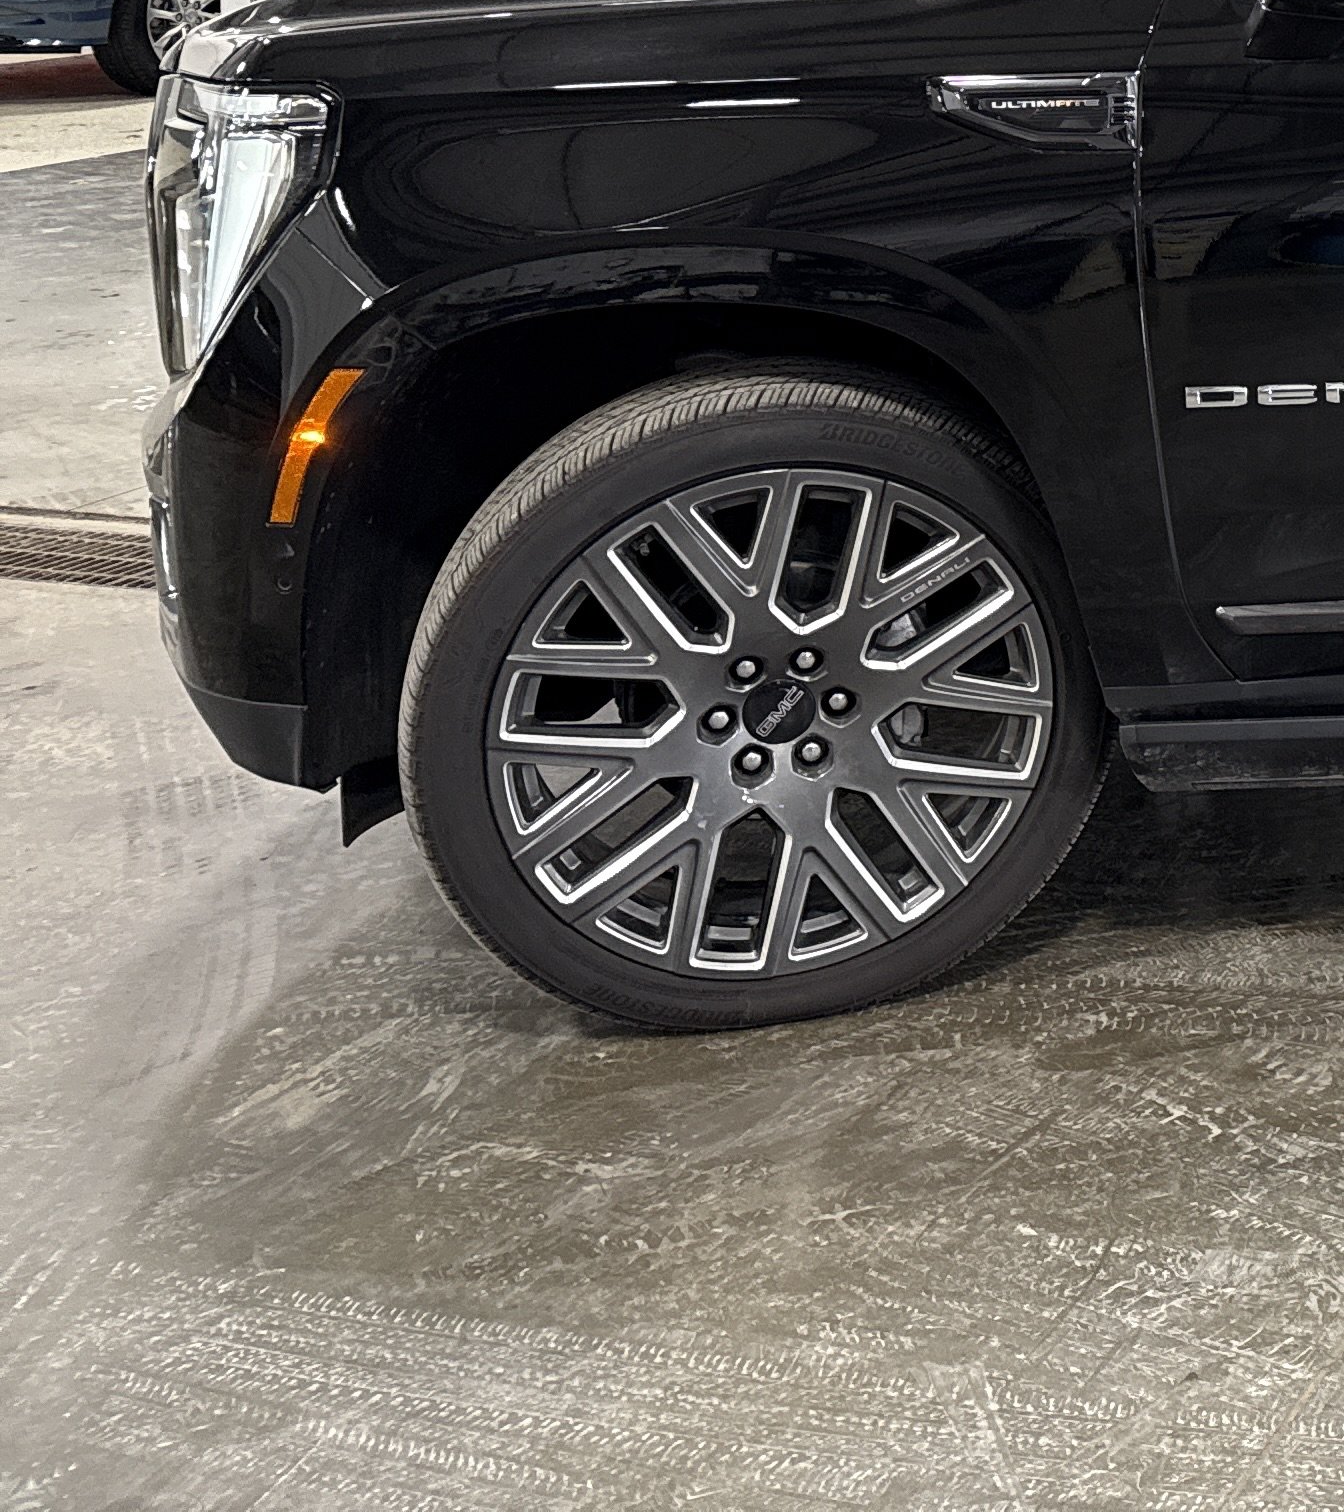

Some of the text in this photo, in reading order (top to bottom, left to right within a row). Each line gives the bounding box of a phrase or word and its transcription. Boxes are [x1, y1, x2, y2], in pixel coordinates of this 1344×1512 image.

[990, 99, 1100, 109] ULTIMATE
[900, 556, 971, 603] DENALI
[755, 684, 805, 738] GMC
